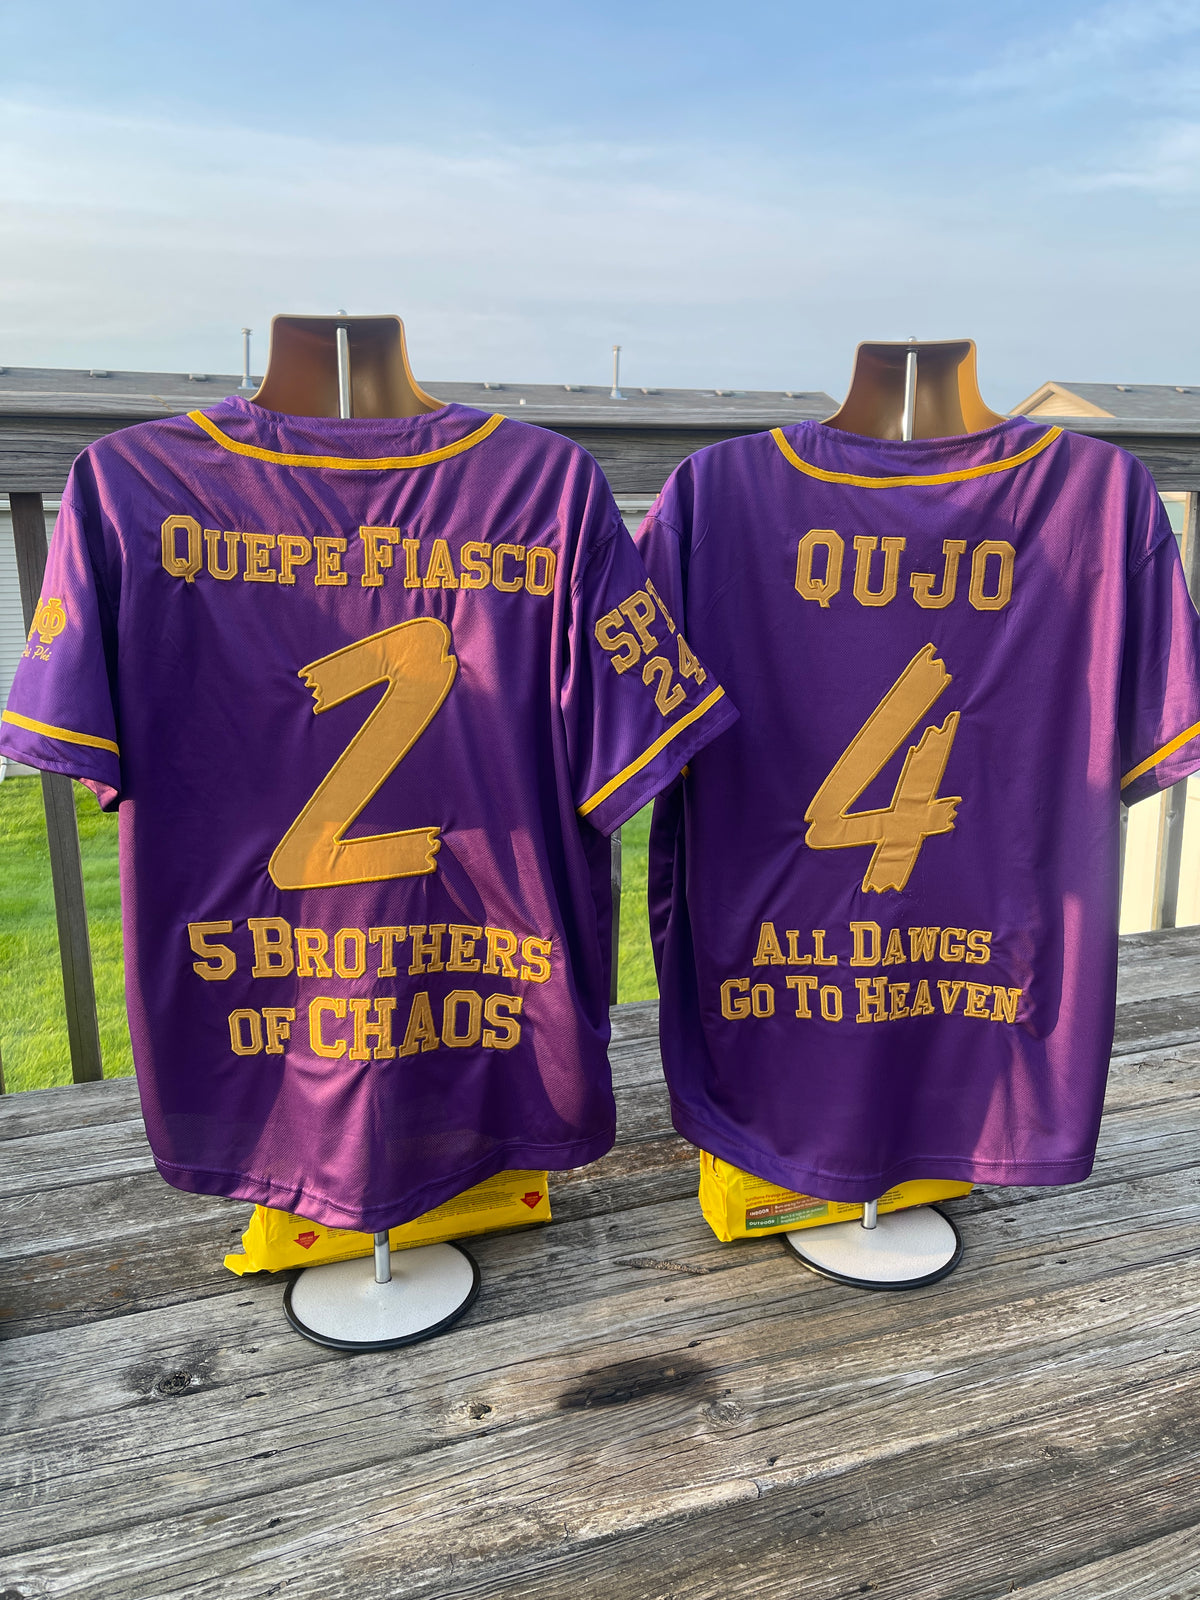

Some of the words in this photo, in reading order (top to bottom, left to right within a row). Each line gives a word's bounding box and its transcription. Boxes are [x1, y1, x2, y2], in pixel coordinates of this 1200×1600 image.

[795, 529, 1016, 610] QUJO
[642, 633, 707, 716] 24
[268, 617, 458, 890] 2
[804, 643, 962, 893] 4
[187, 920, 237, 981] 5
[228, 1007, 296, 1056] OF
[308, 989, 523, 1060] CHAOS
